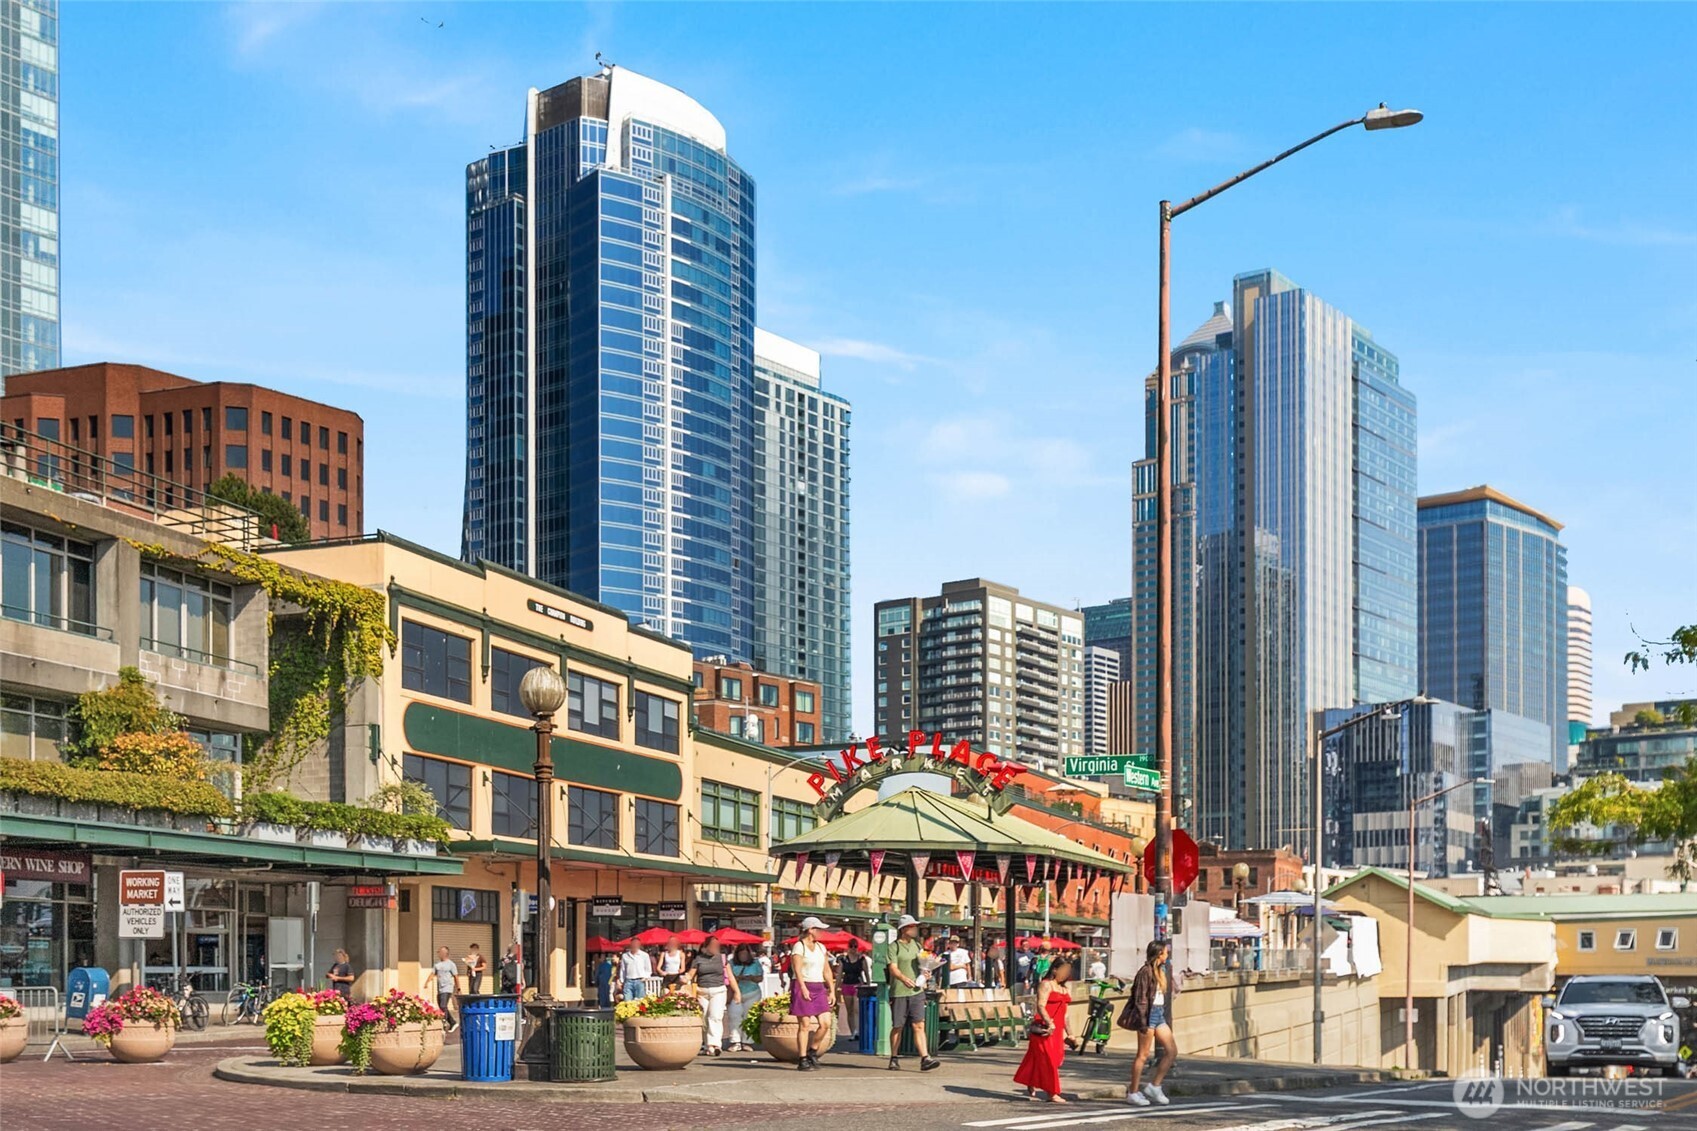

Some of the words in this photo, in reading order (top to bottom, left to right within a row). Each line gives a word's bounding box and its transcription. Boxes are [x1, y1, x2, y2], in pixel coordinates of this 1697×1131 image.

[806, 735, 884, 802] PIKE
[908, 729, 1017, 790] PLACE
[1069, 758, 1118, 774] Virginia
[829, 757, 994, 803] MARKET
[1126, 767, 1150, 786] Western
[25, 858, 55, 873] WINE
[58, 861, 85, 874] SHOP
[126, 877, 160, 887] WORKING
[126, 889, 159, 899] MARKET
[123, 908, 162, 916] AUTHORIZED
[127, 918, 157, 926] VEHICLES
[133, 927, 149, 935] ONLY
[1665, 986, 1686, 994] arket
